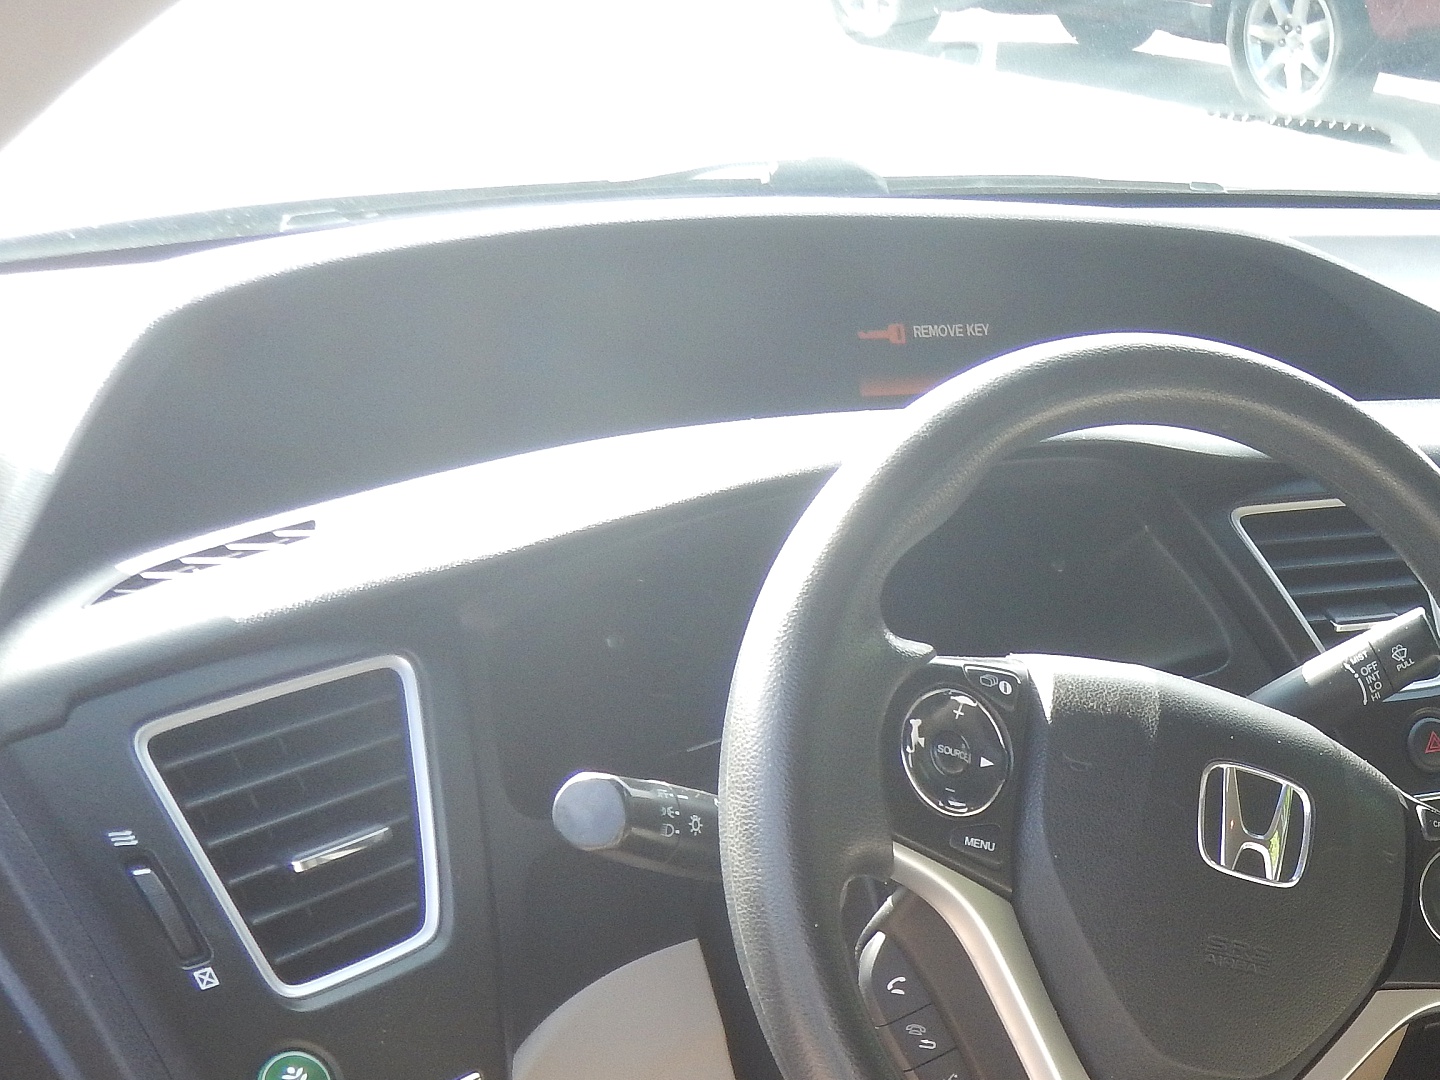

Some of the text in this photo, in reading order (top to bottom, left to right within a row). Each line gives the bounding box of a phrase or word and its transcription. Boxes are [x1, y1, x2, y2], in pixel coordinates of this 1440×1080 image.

[913, 323, 989, 338] REMOVE KEY
[1350, 650, 1368, 665] MIST
[1396, 658, 1415, 672] PULL
[1360, 660, 1378, 676] OFF
[1365, 670, 1381, 684] INT
[1368, 681, 1382, 693] LO
[1370, 691, 1381, 702] HI
[937, 744, 972, 764] SOURCE
[964, 836, 996, 852] MENU
